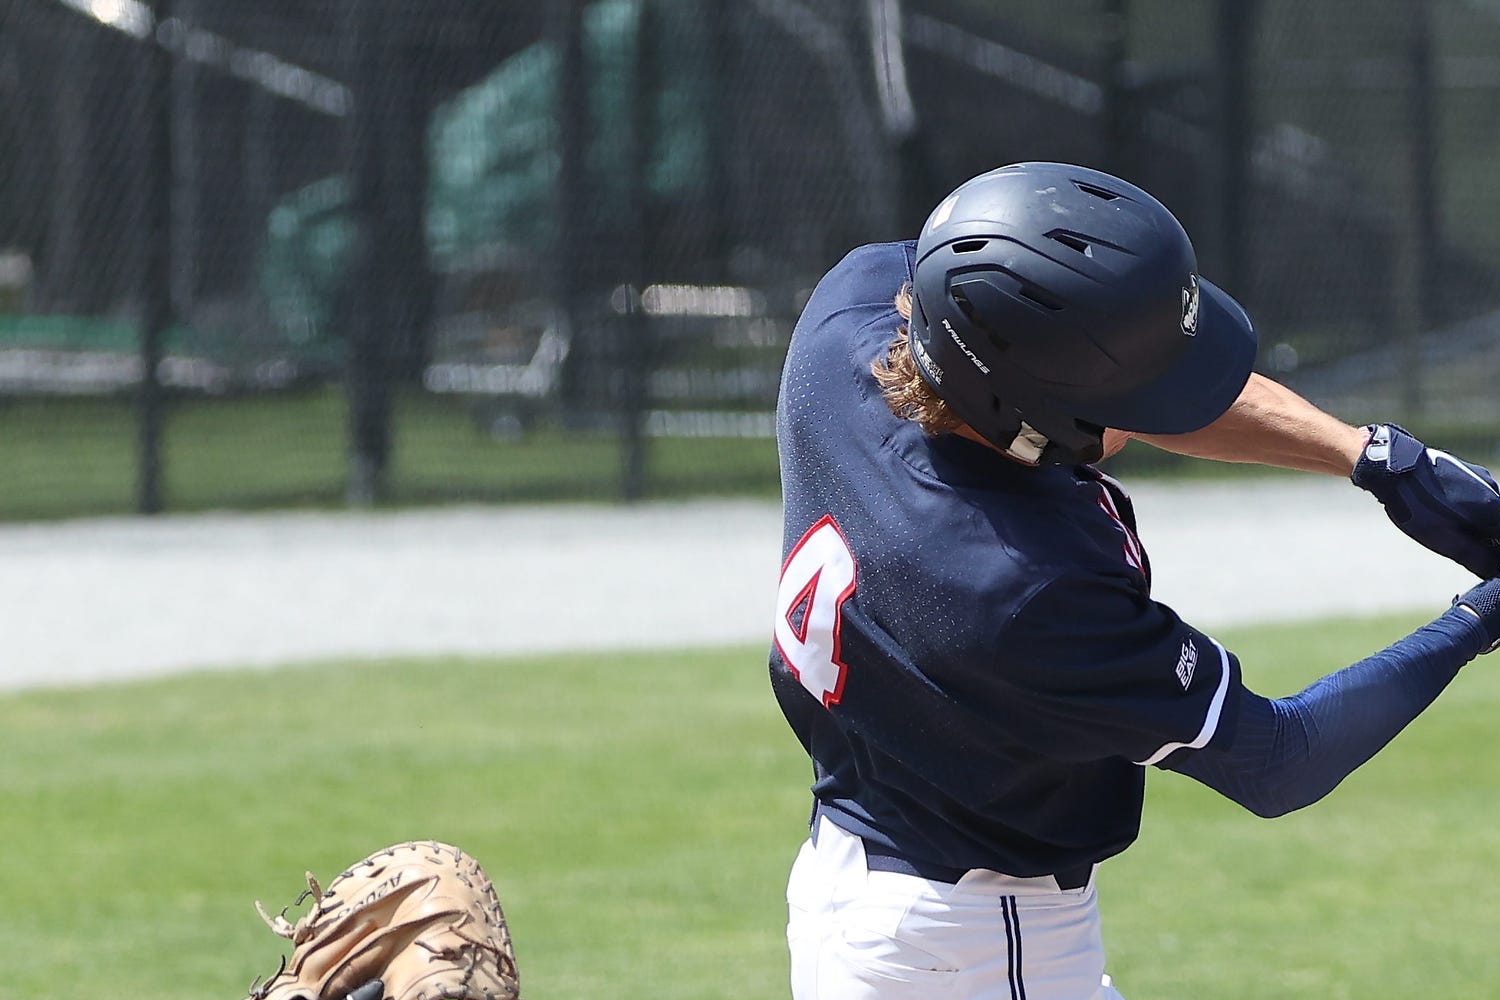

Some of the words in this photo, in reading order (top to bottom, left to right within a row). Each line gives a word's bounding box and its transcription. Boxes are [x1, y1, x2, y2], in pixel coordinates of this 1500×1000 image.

[942, 319, 990, 374] RAWLINGS
[774, 514, 859, 711] 4
[1175, 642, 1189, 679] BIG
[1180, 639, 1197, 687] EAST
